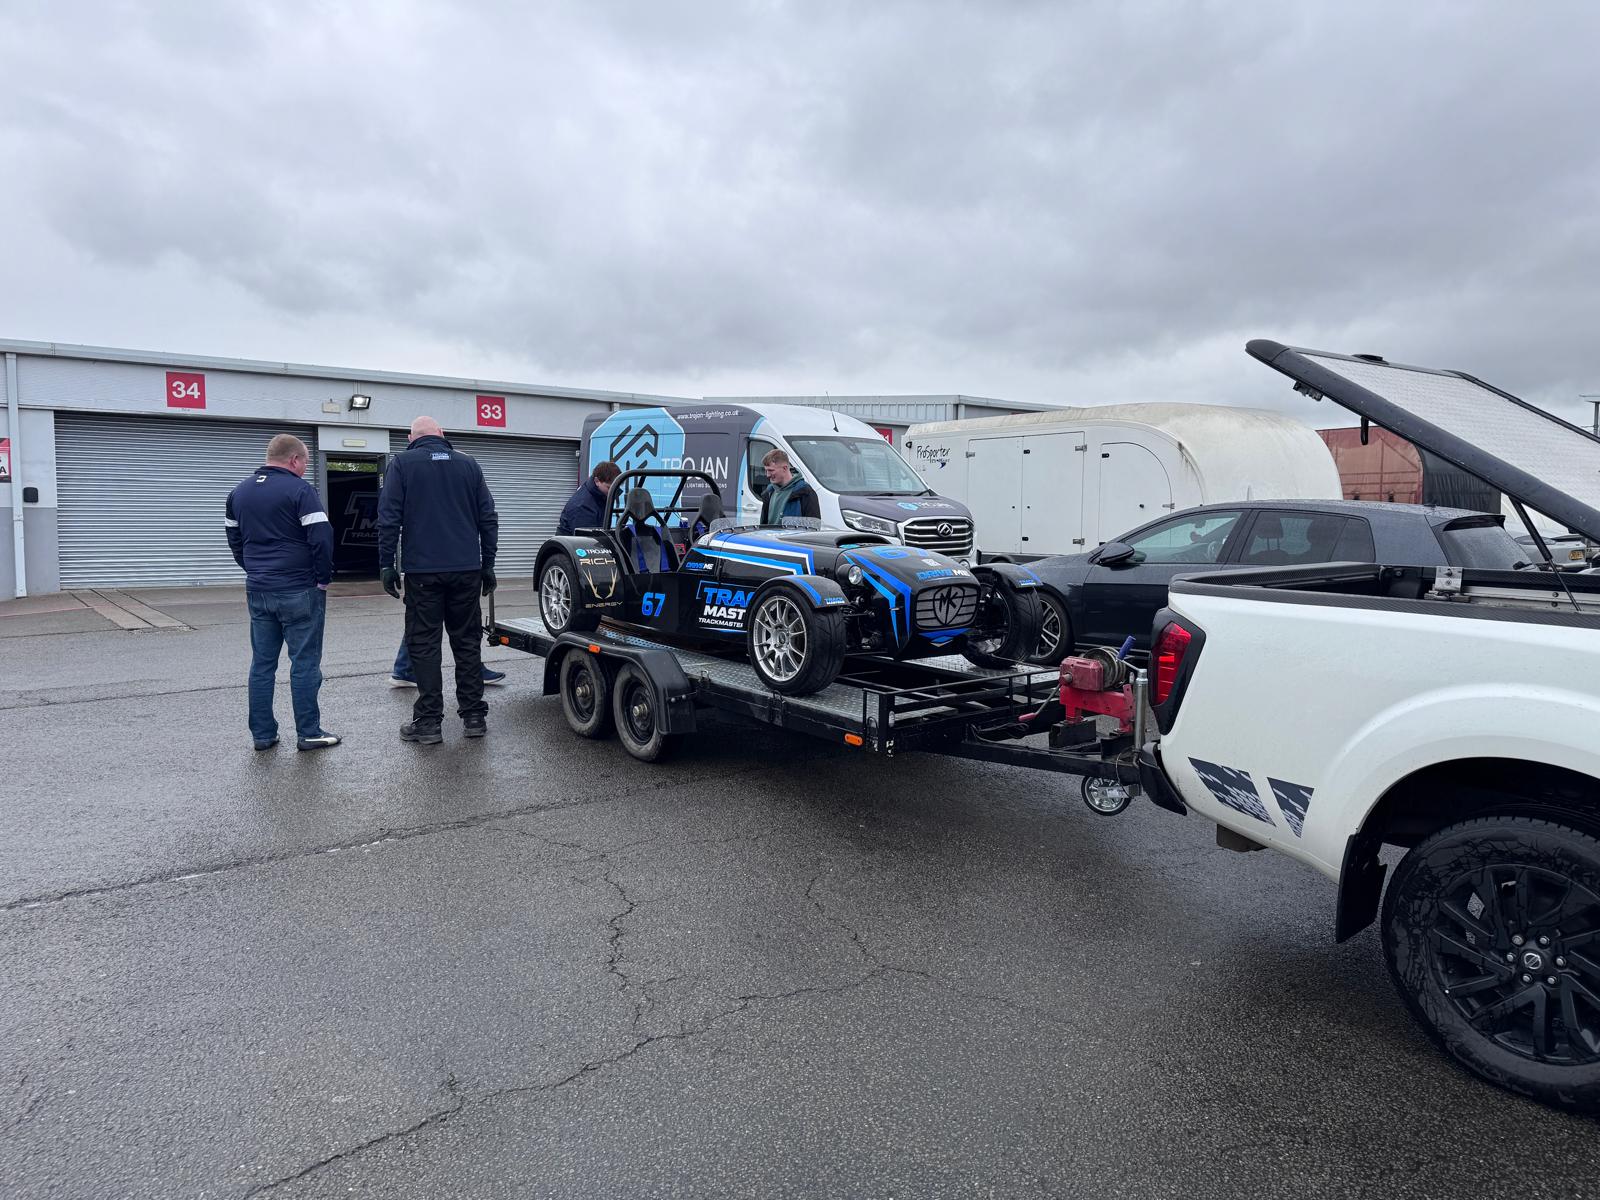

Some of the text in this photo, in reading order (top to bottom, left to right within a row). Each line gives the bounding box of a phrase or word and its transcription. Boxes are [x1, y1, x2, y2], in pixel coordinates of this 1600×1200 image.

[171, 381, 201, 399] 34
[480, 403, 502, 420] 33
[661, 456, 729, 480] TROJAN
[579, 558, 616, 566] RICH
[641, 591, 666, 617] 67
